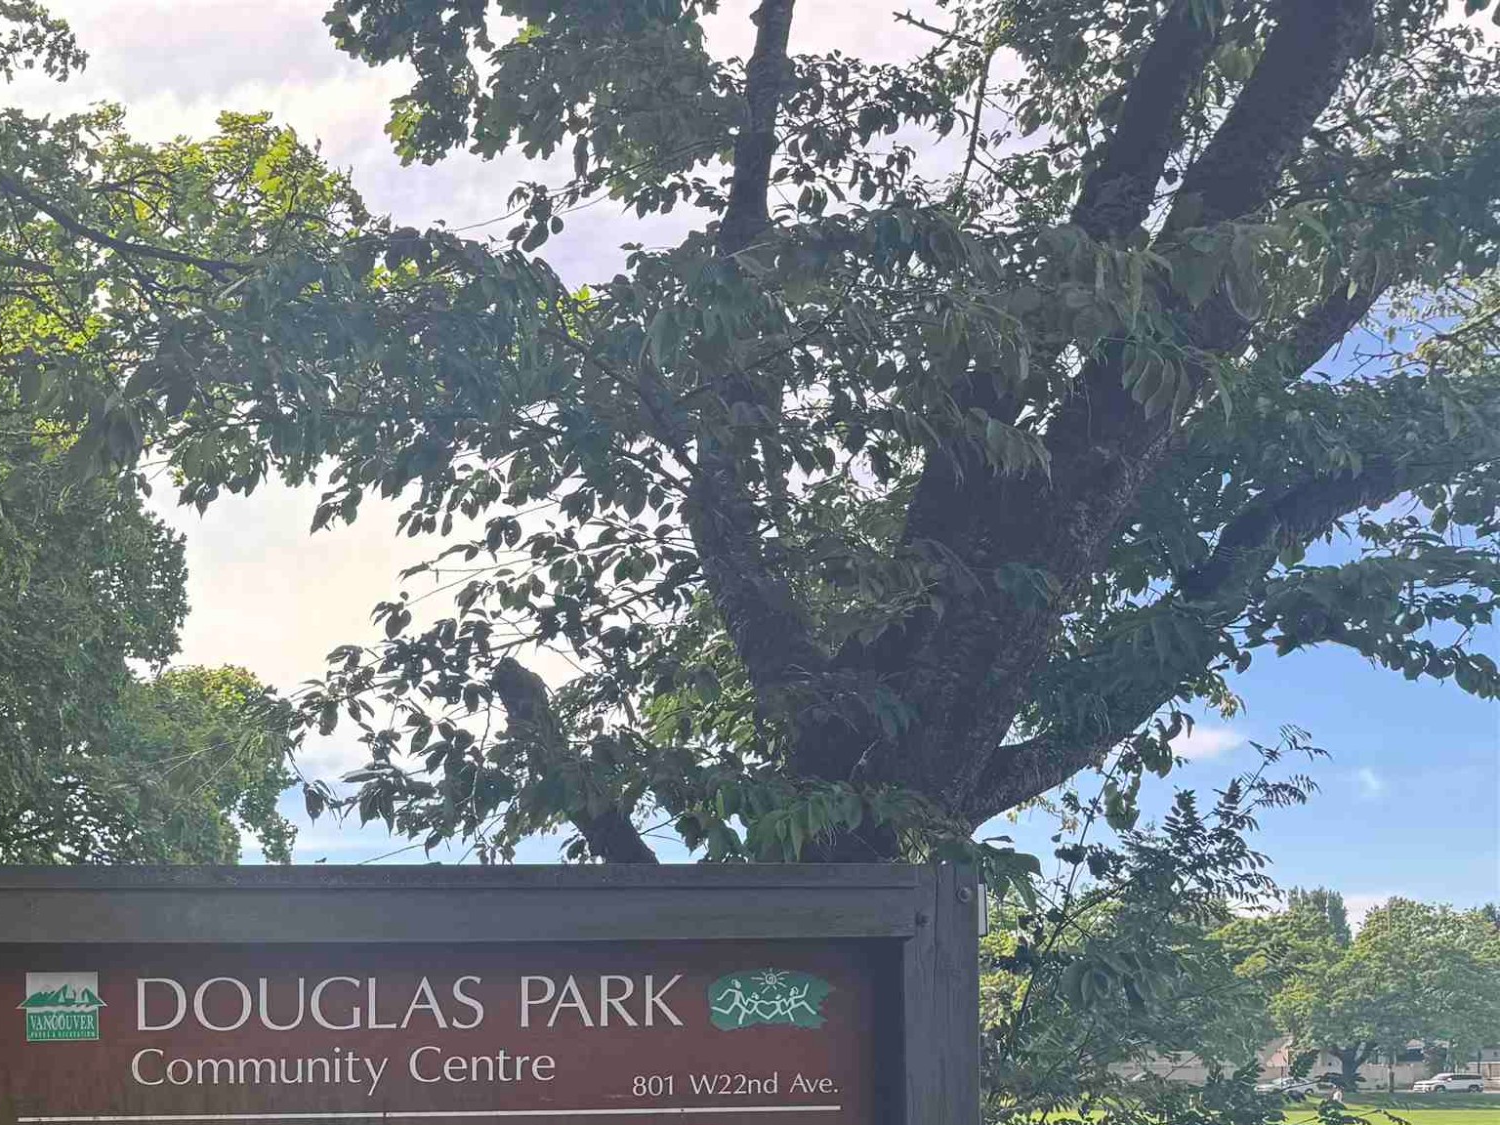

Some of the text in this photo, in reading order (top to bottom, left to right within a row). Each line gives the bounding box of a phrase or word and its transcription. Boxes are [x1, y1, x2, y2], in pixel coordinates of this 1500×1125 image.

[136, 974, 684, 1031] DOUGLAS PARK
[30, 1013, 95, 1031] VANCOUVER
[131, 1045, 556, 1096] Community Centre
[632, 1071, 839, 1096] 801 W22nd Ave.
